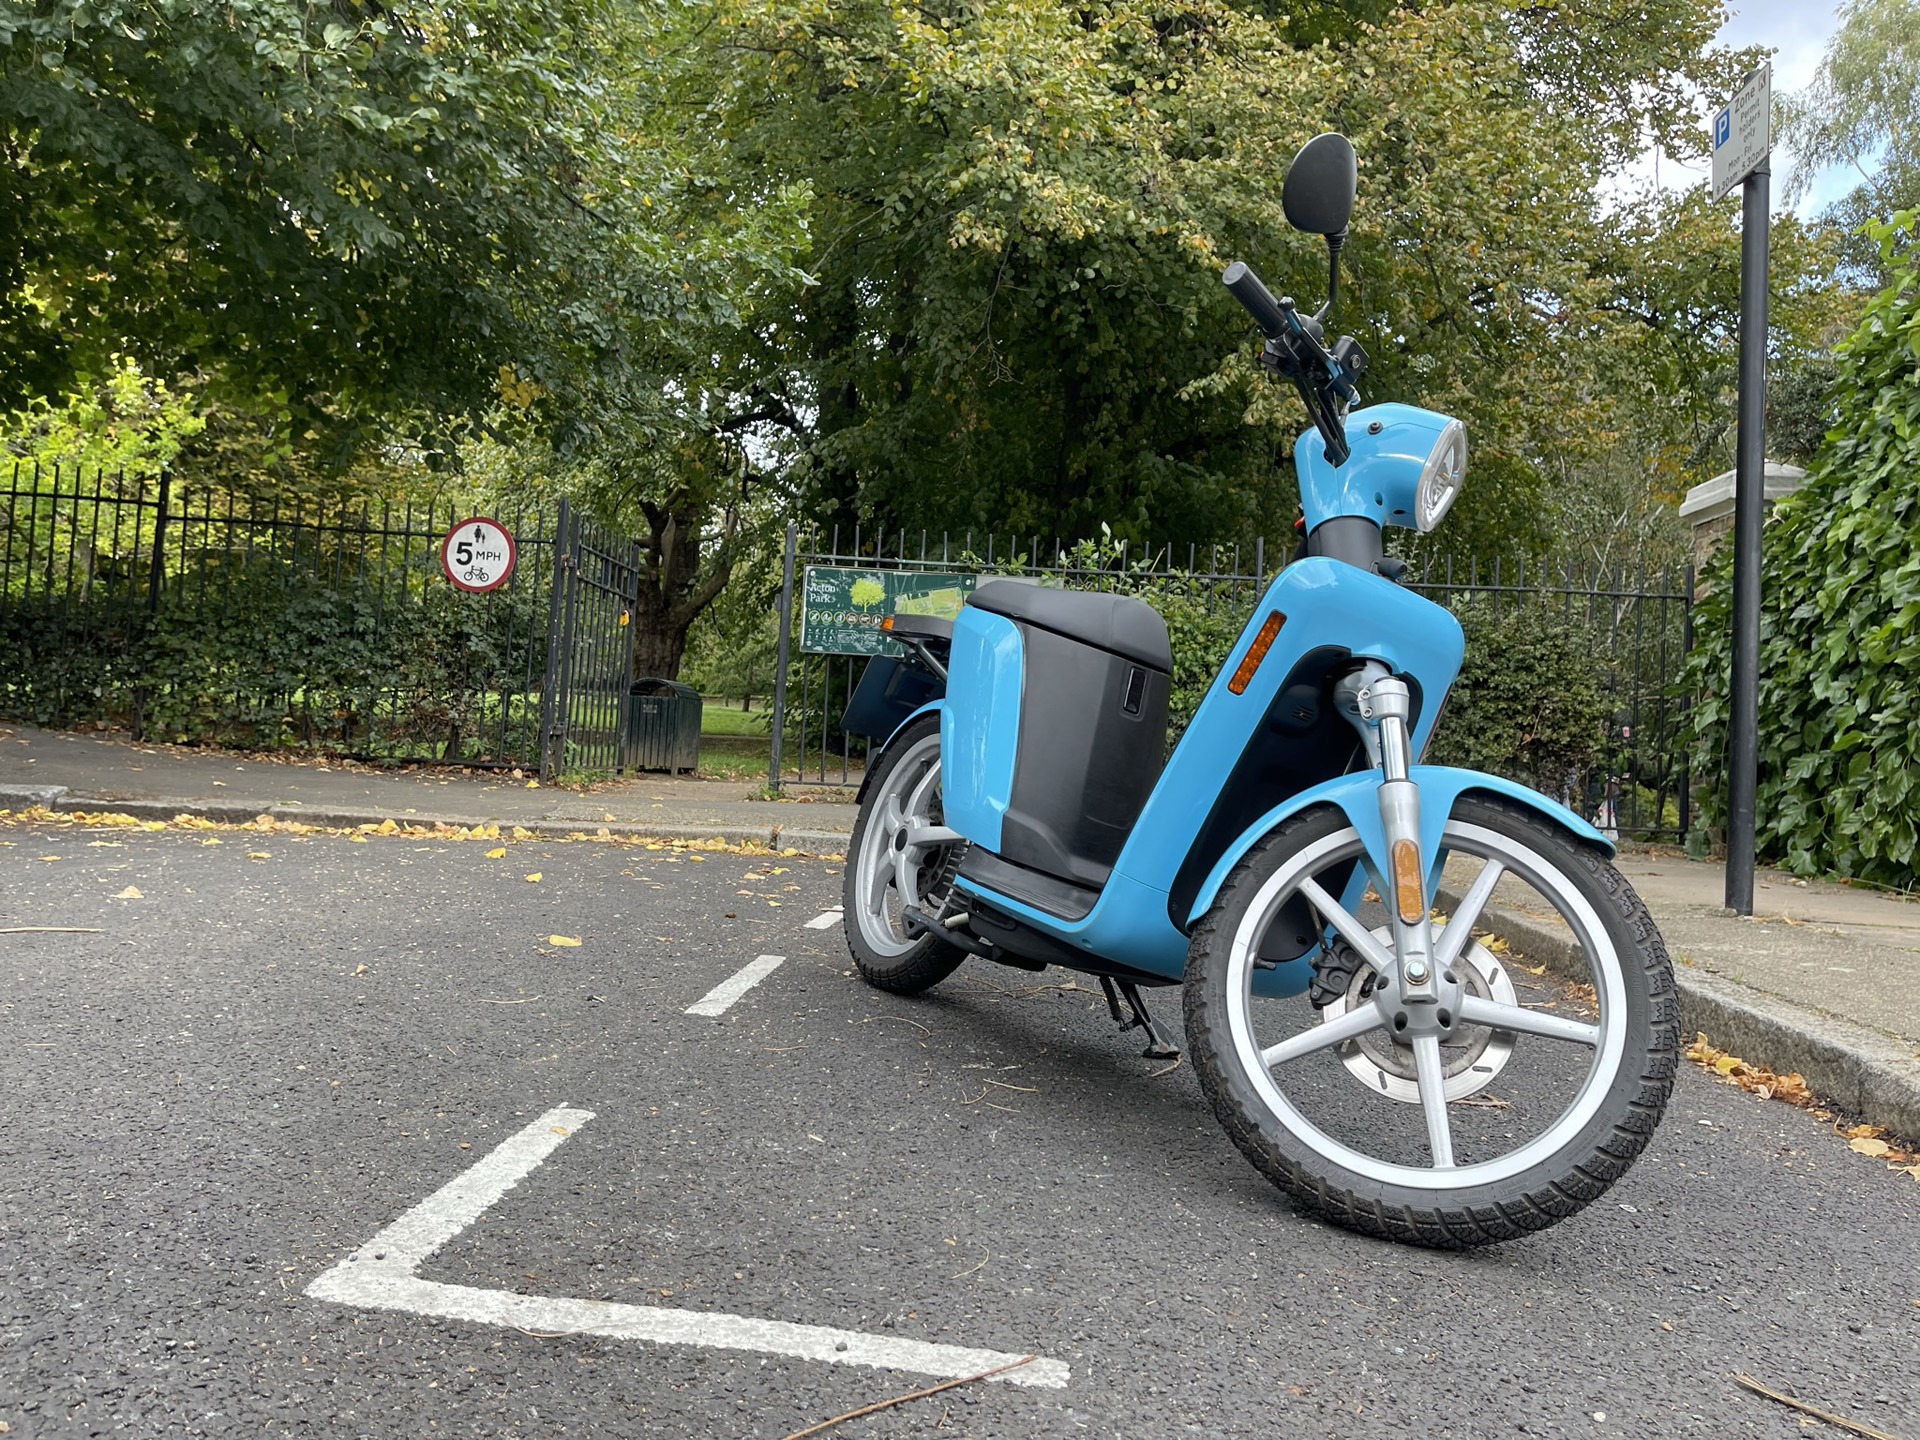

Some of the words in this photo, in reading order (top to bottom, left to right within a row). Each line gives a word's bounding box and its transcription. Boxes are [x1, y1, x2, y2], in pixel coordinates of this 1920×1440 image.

[1734, 86, 1756, 114] Zone
[1740, 98, 1760, 121] Permit
[1718, 114, 1729, 144] P
[1738, 110, 1761, 135] holders
[1743, 125, 1756, 143] only
[1728, 155, 1740, 172] Mon
[1744, 142, 1752, 157] Fri
[1741, 146, 1765, 172] 5.30pm
[456, 541, 473, 566] 5
[475, 551, 502, 561] MPH
[809, 583, 836, 593] Acton
